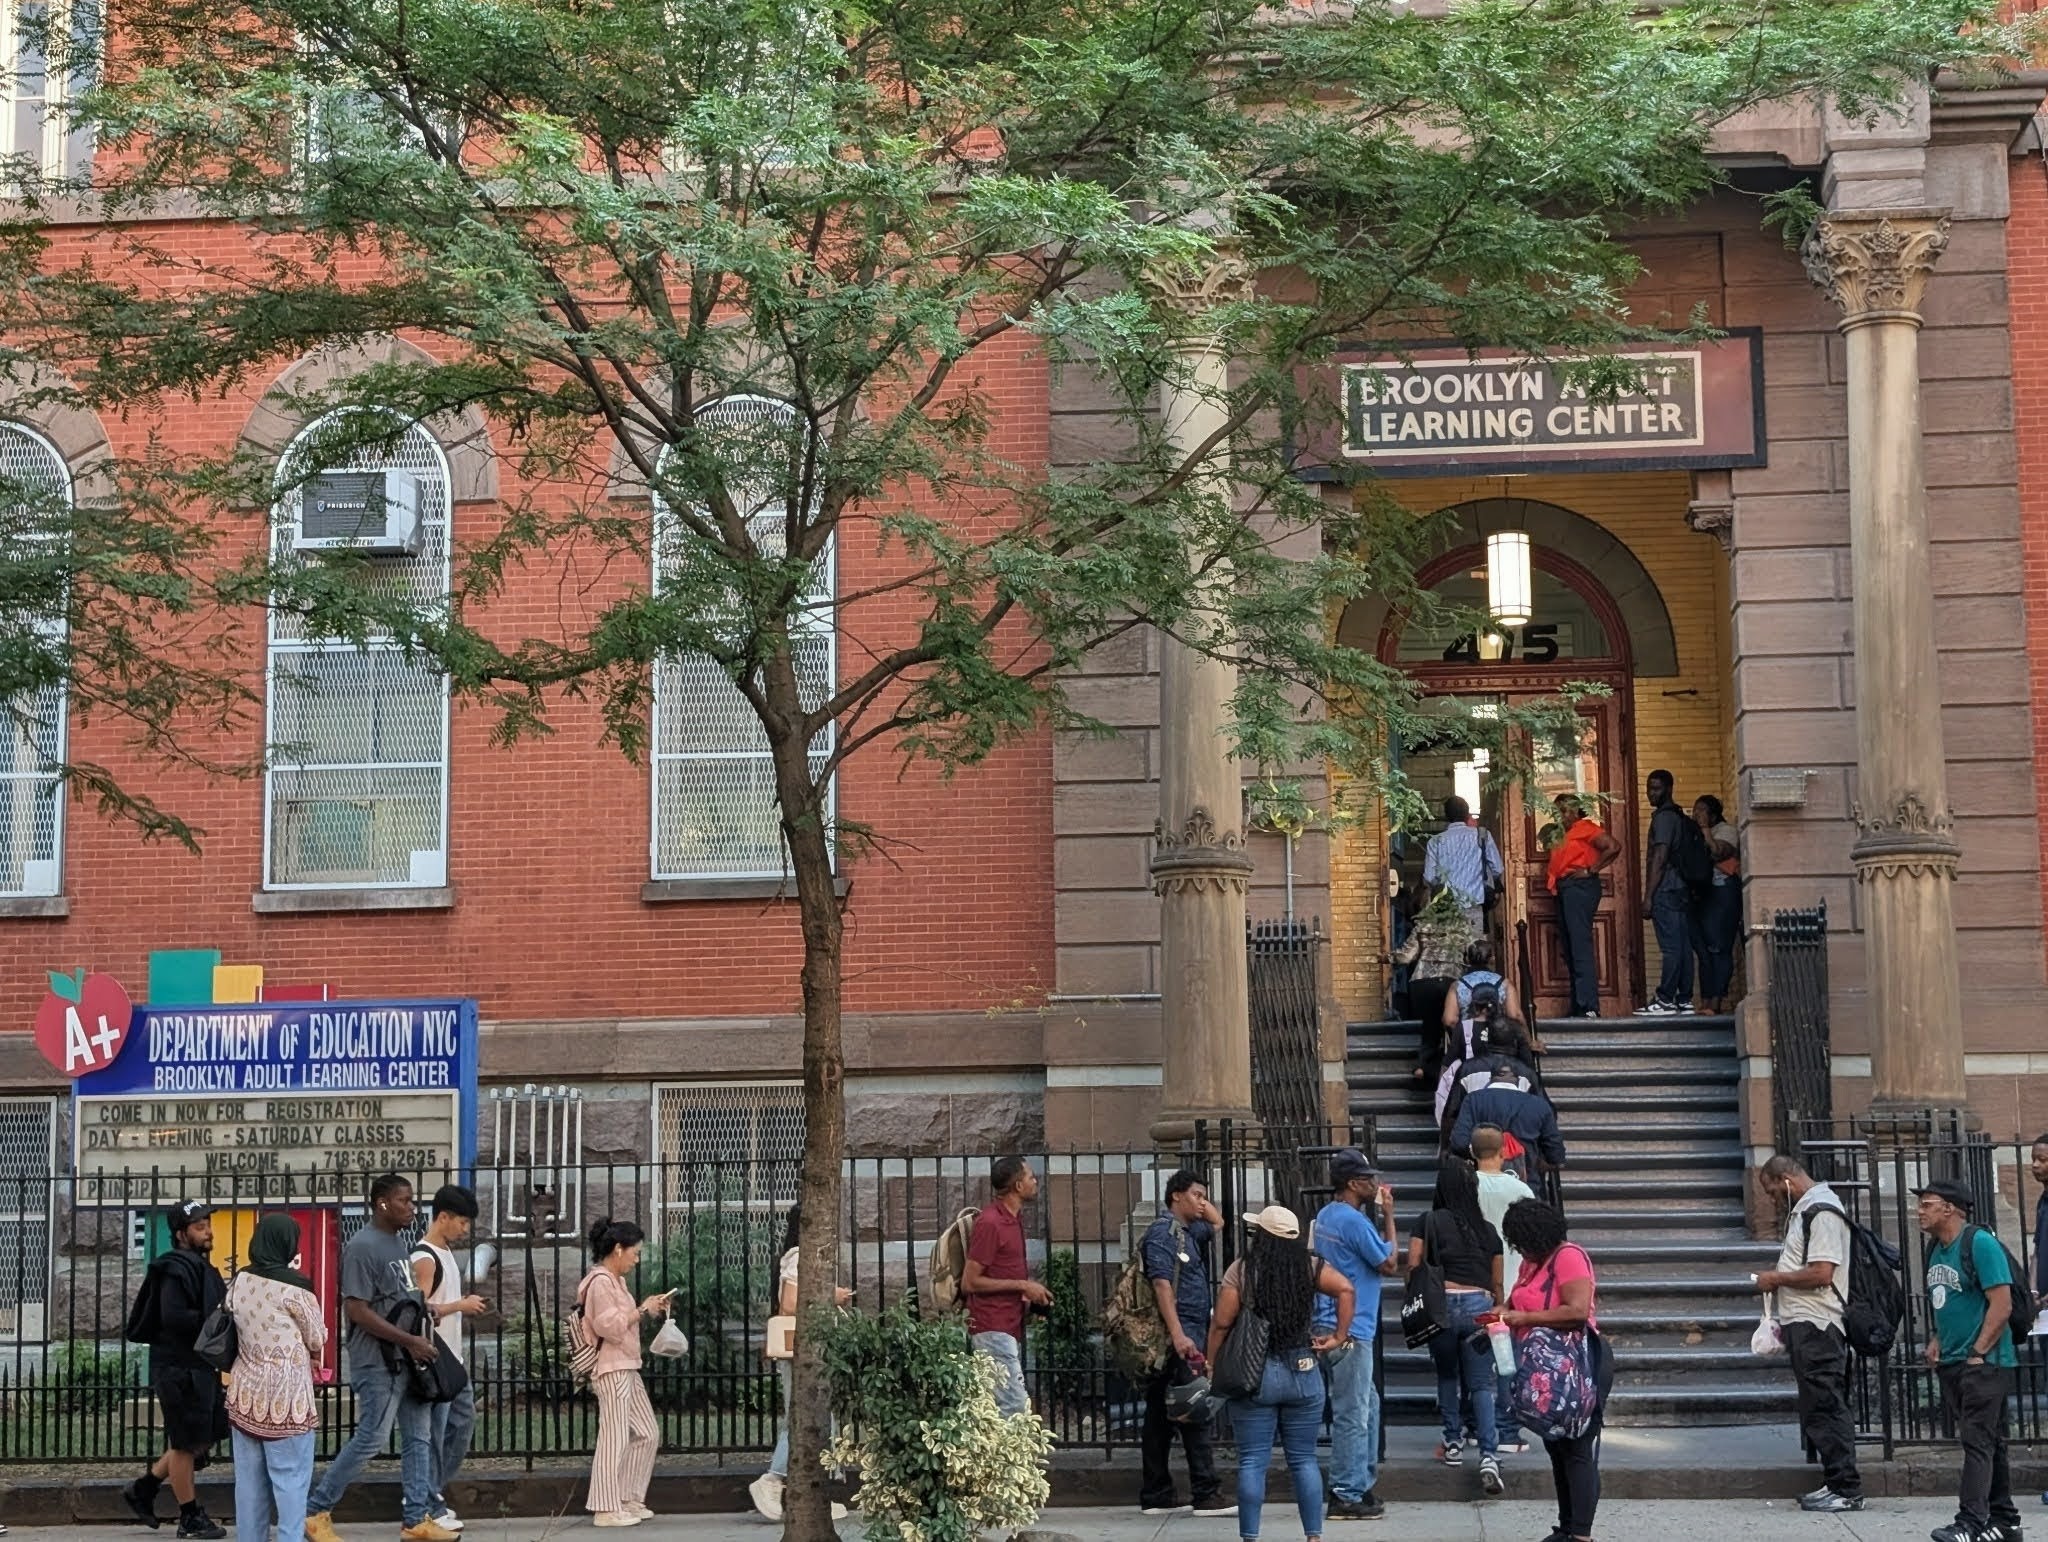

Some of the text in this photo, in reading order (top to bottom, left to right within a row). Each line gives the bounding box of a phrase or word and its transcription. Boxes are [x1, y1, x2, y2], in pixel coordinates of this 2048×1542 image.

[1360, 371, 1543, 405] BROOKLYN
[1362, 403, 1684, 441] LEARNING CENTER
[65, 1006, 120, 1071] A+
[148, 1010, 457, 1062] DEPARTMENT OF EDUCATION NYC
[154, 1060, 449, 1091] BROOKLYN ADULT LEARNING CENTER
[100, 1100, 382, 1122] COME IN NOW FOR REGISTRATION
[88, 1129, 121, 1148] DAY
[148, 1128, 212, 1146] EVENING
[334, 1125, 405, 1143] CLASSES
[205, 1152, 279, 1170] WELCOME
